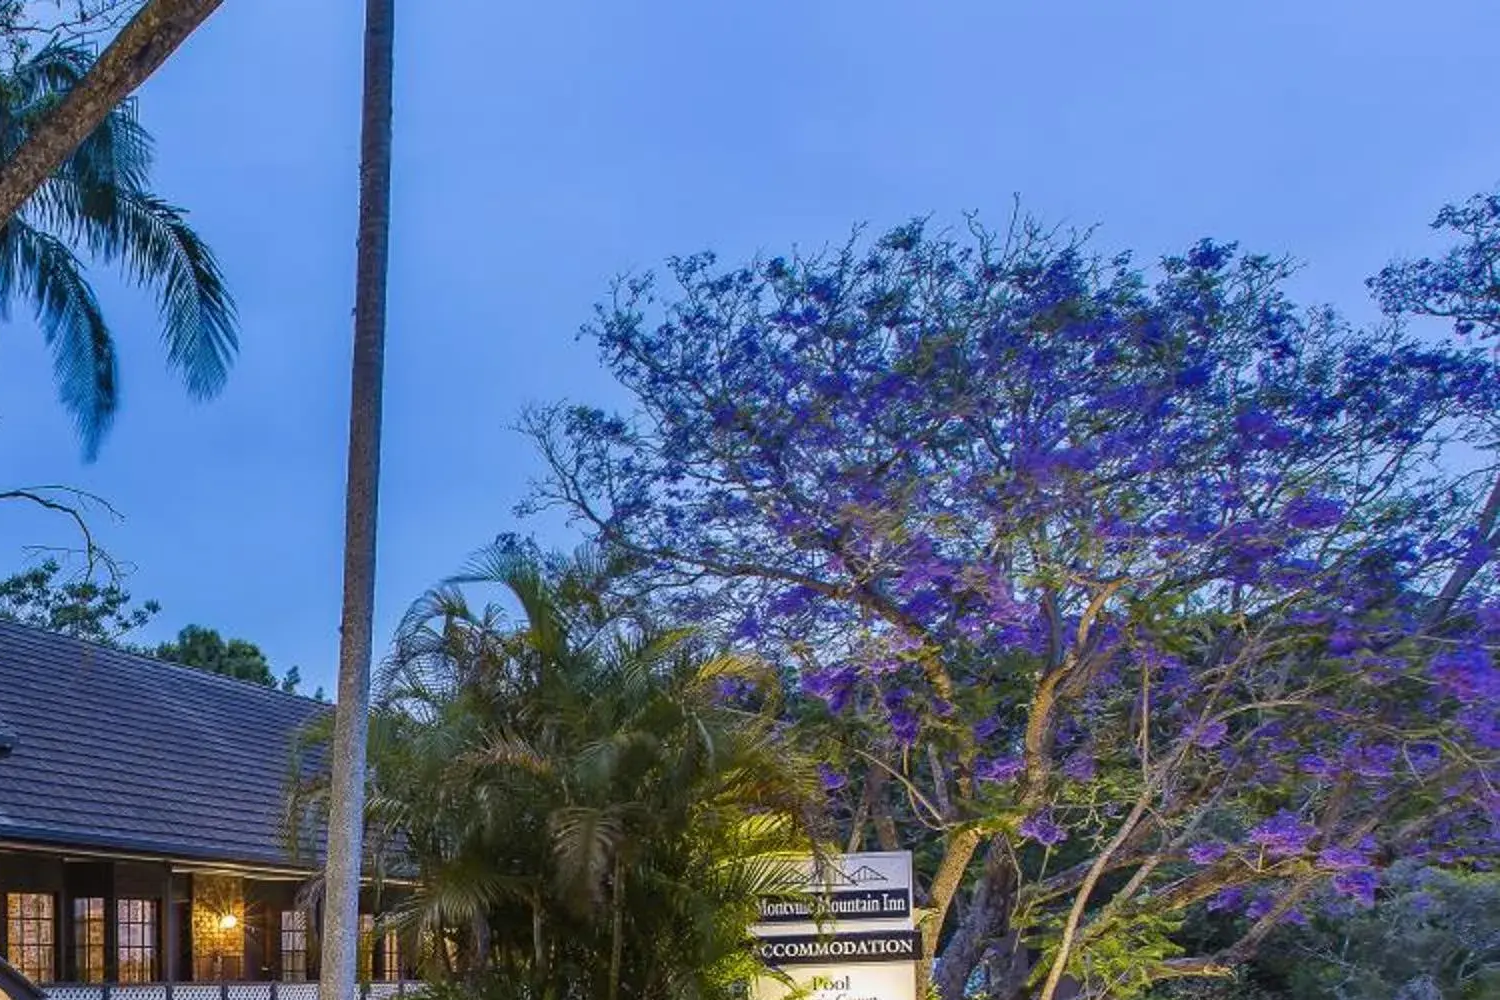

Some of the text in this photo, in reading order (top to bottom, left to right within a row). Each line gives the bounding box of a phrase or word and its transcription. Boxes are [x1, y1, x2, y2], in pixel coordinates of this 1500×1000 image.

[882, 893, 906, 911] Inn
[754, 939, 914, 958] CCOMMODATION
[812, 975, 852, 991] Pool
